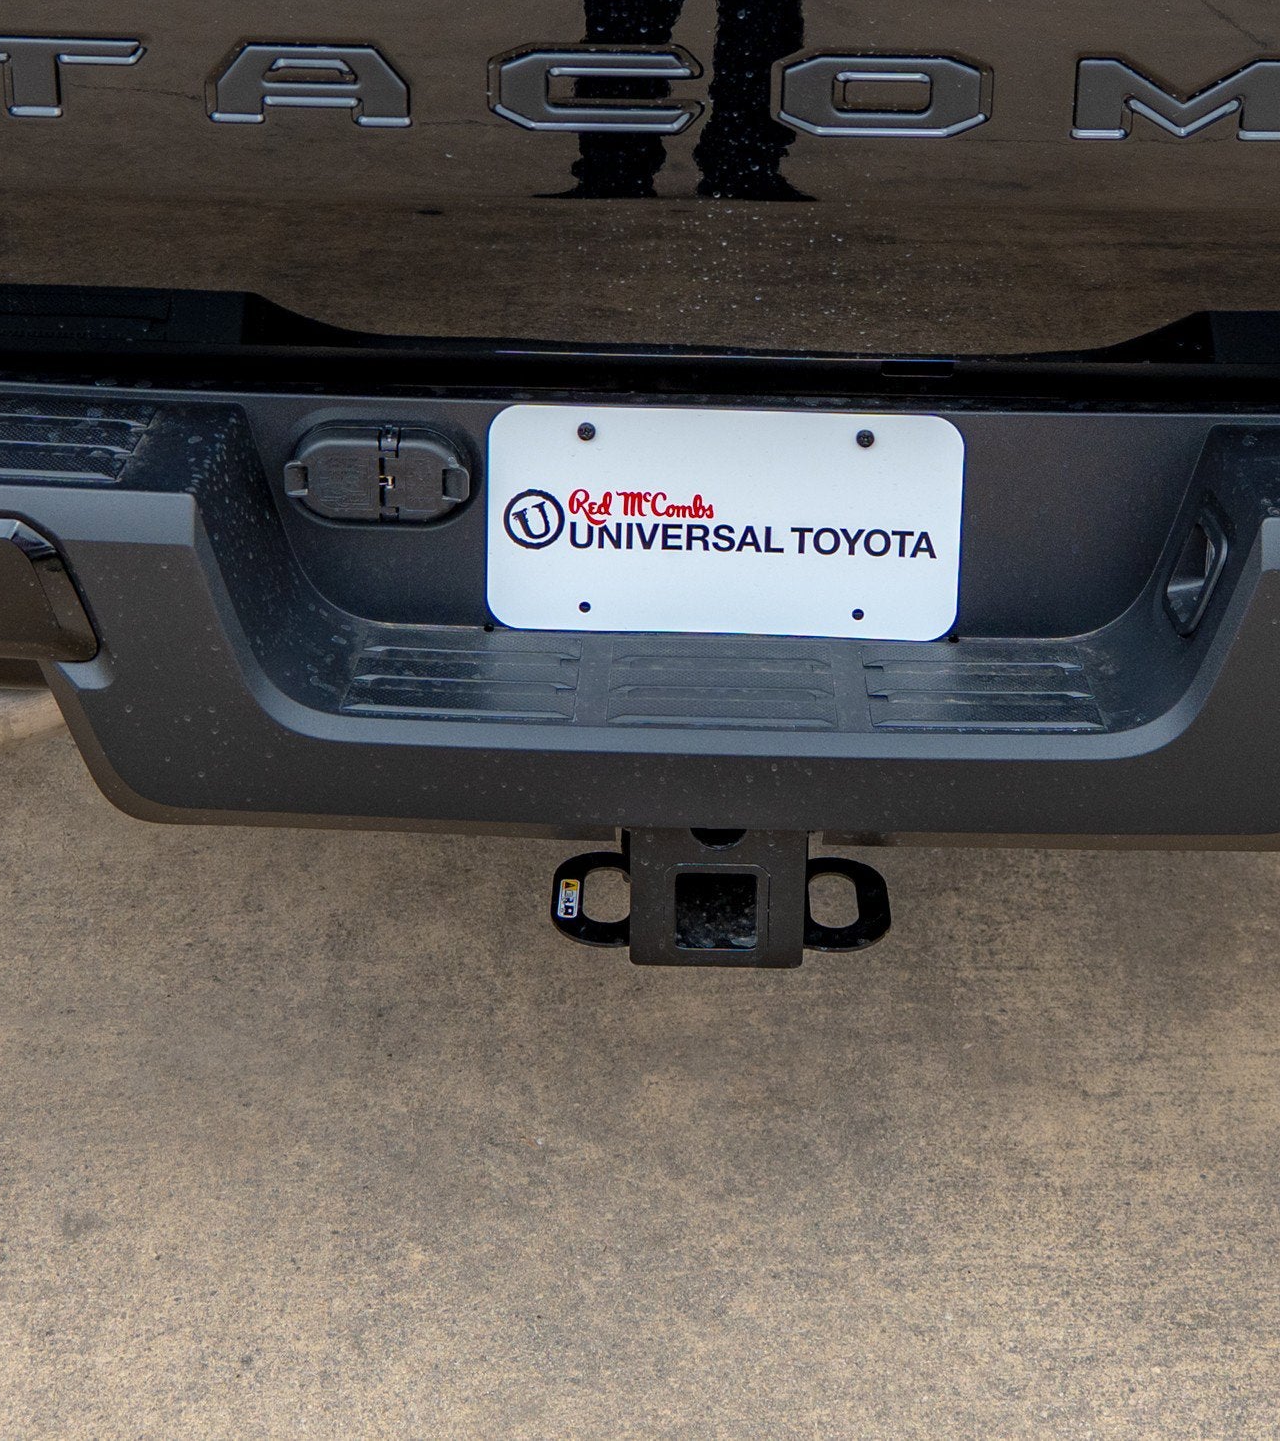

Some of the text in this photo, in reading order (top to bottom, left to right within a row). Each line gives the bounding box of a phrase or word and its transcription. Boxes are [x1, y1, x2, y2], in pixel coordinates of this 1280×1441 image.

[568, 488, 715, 526] Red McCombs
[569, 520, 937, 560] UNIVERSAL TOYOTA
